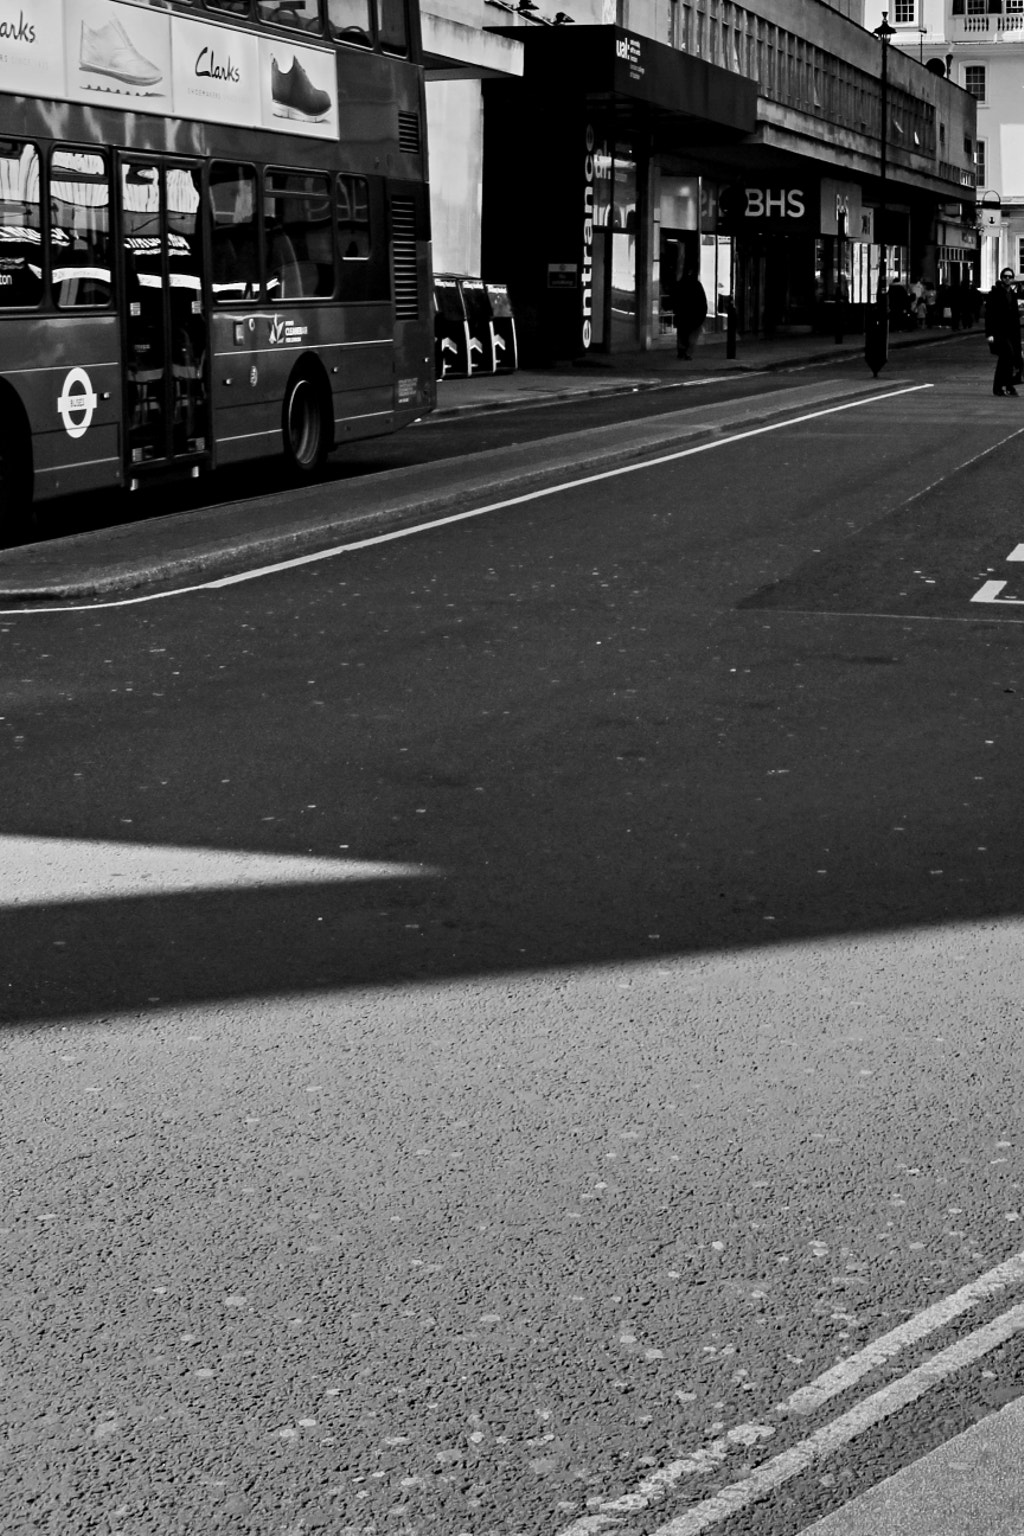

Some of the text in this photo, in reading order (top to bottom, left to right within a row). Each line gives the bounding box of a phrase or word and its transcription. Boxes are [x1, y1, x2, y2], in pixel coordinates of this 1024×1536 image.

[195, 46, 240, 82] Clarks
[745, 189, 806, 218] BHS
[581, 123, 595, 349] entrance
